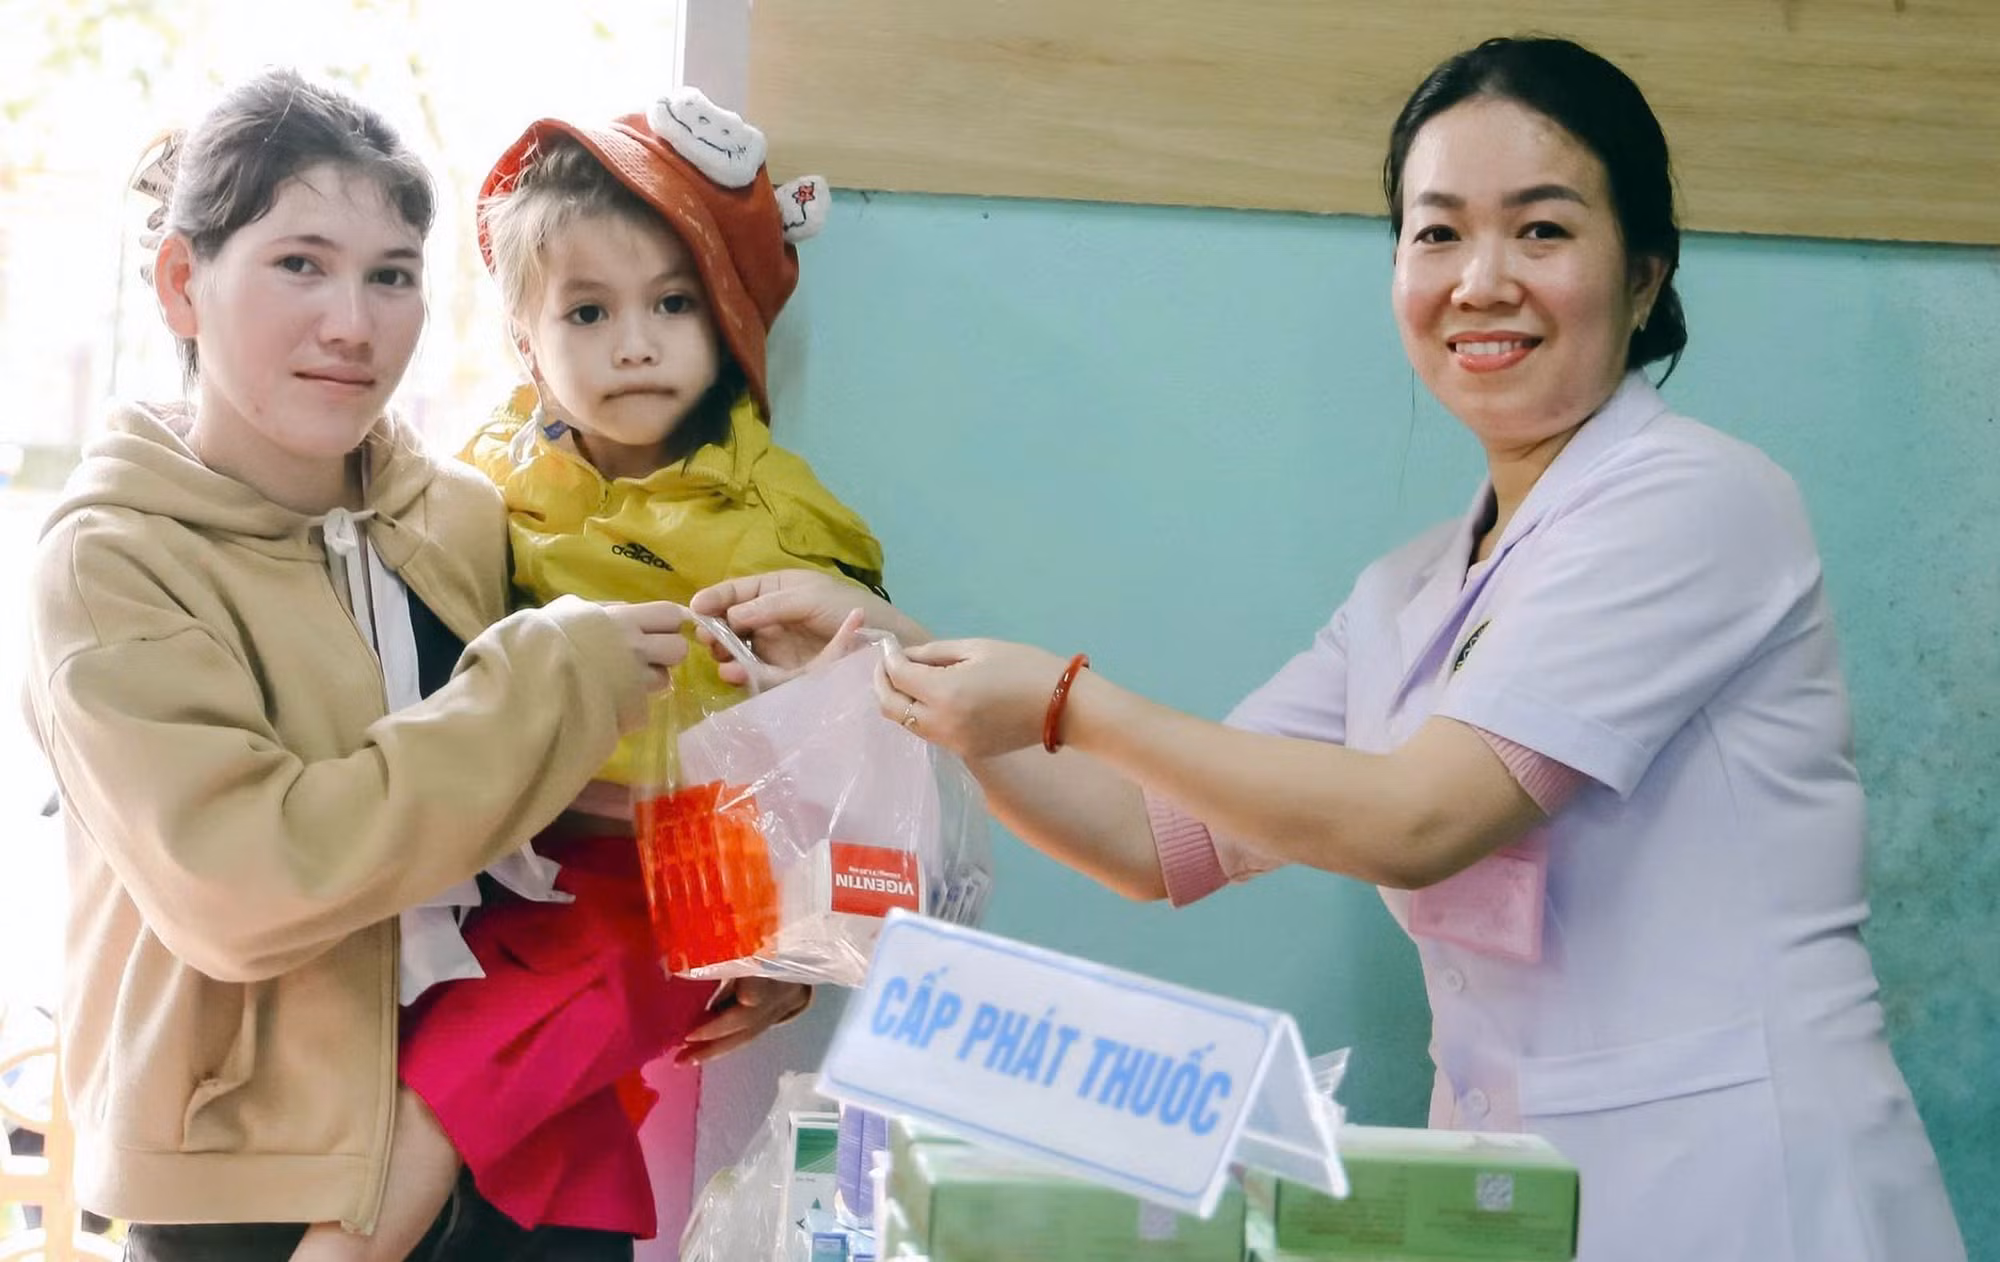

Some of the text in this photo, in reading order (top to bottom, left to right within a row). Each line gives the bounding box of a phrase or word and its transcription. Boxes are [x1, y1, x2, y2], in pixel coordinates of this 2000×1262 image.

[835, 873, 914, 896] VIGENTIN
[870, 966, 1232, 1136] CẤP PHÁT THUỐC
